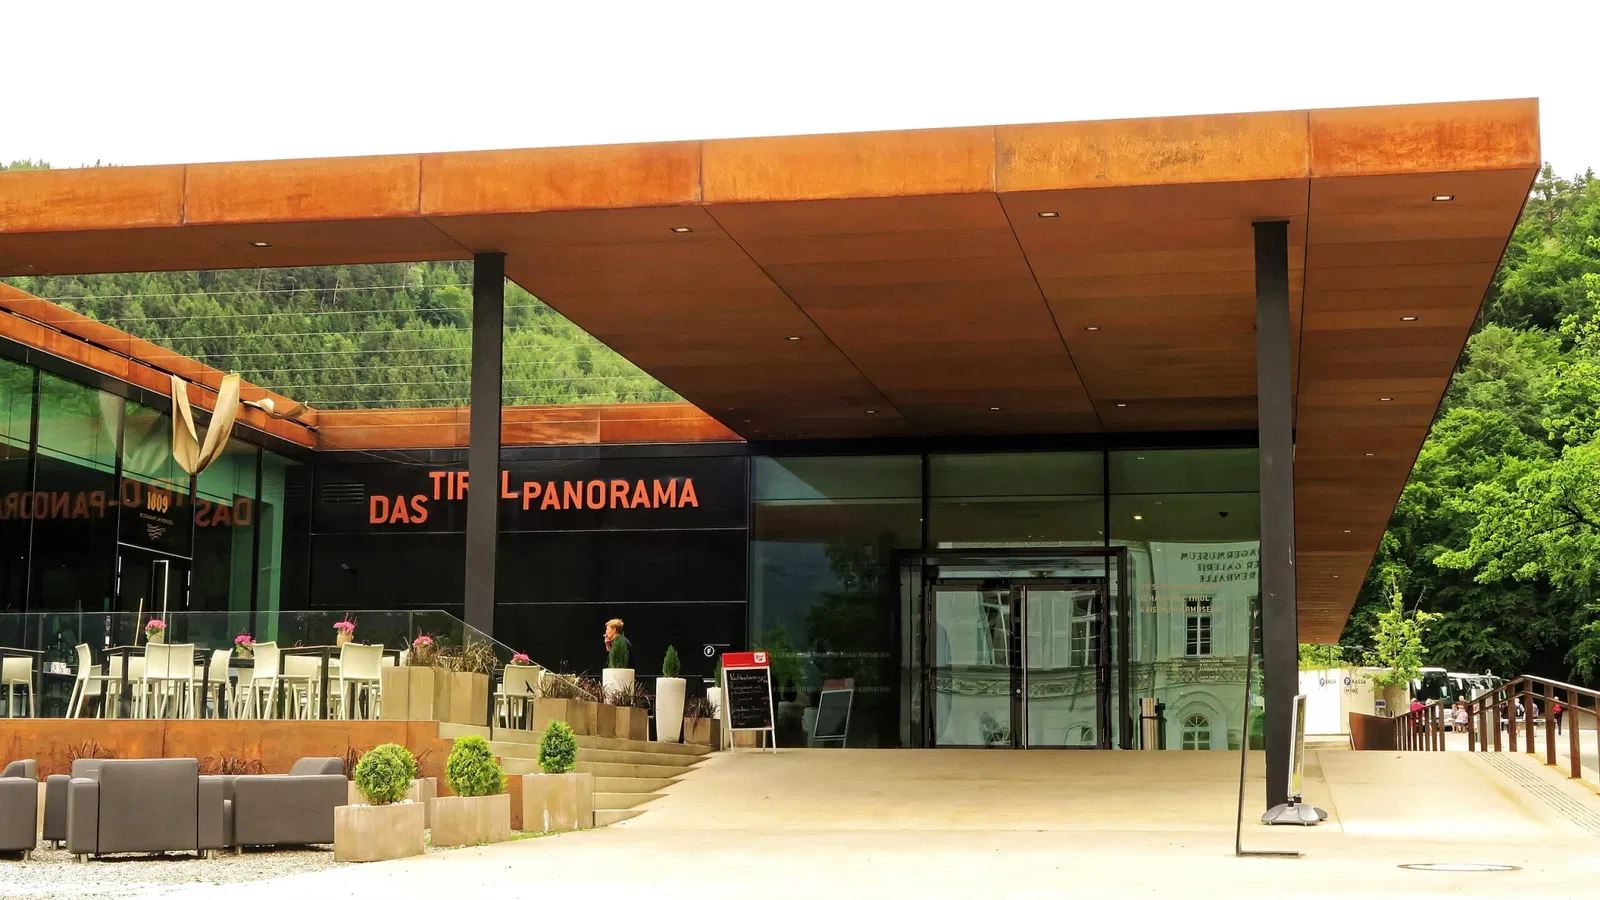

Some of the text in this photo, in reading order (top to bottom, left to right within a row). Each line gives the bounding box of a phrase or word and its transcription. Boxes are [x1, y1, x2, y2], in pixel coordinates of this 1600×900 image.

[147, 491, 169, 514] 1809
[369, 470, 699, 524] DAS TIRL PANORAMA
